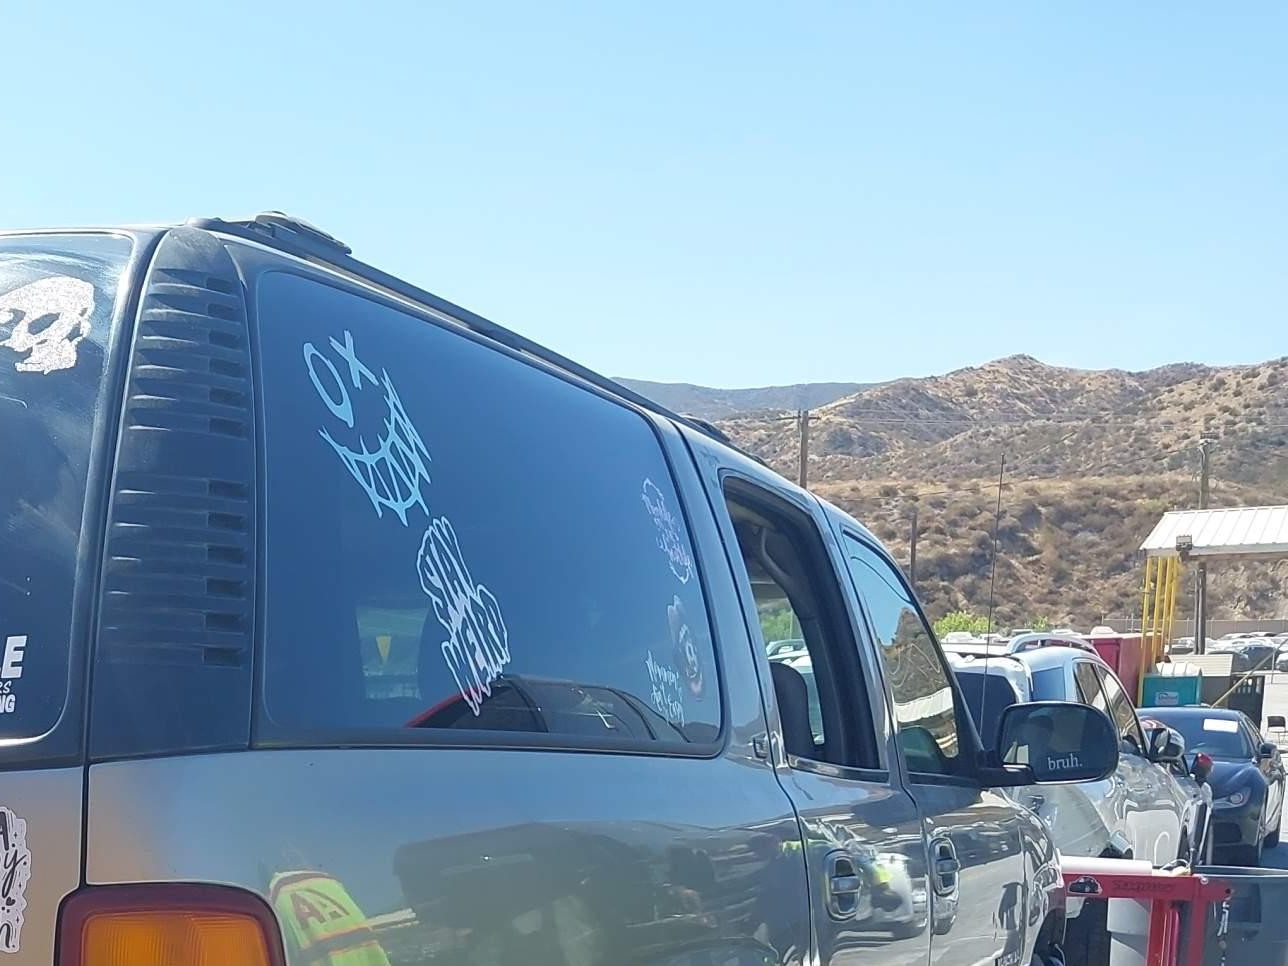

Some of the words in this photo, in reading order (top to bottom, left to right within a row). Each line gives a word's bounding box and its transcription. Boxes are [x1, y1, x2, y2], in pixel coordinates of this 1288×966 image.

[417, 516, 478, 637] STAY
[442, 584, 511, 716] WEIRD
[1048, 753, 1083, 770] bruh.
